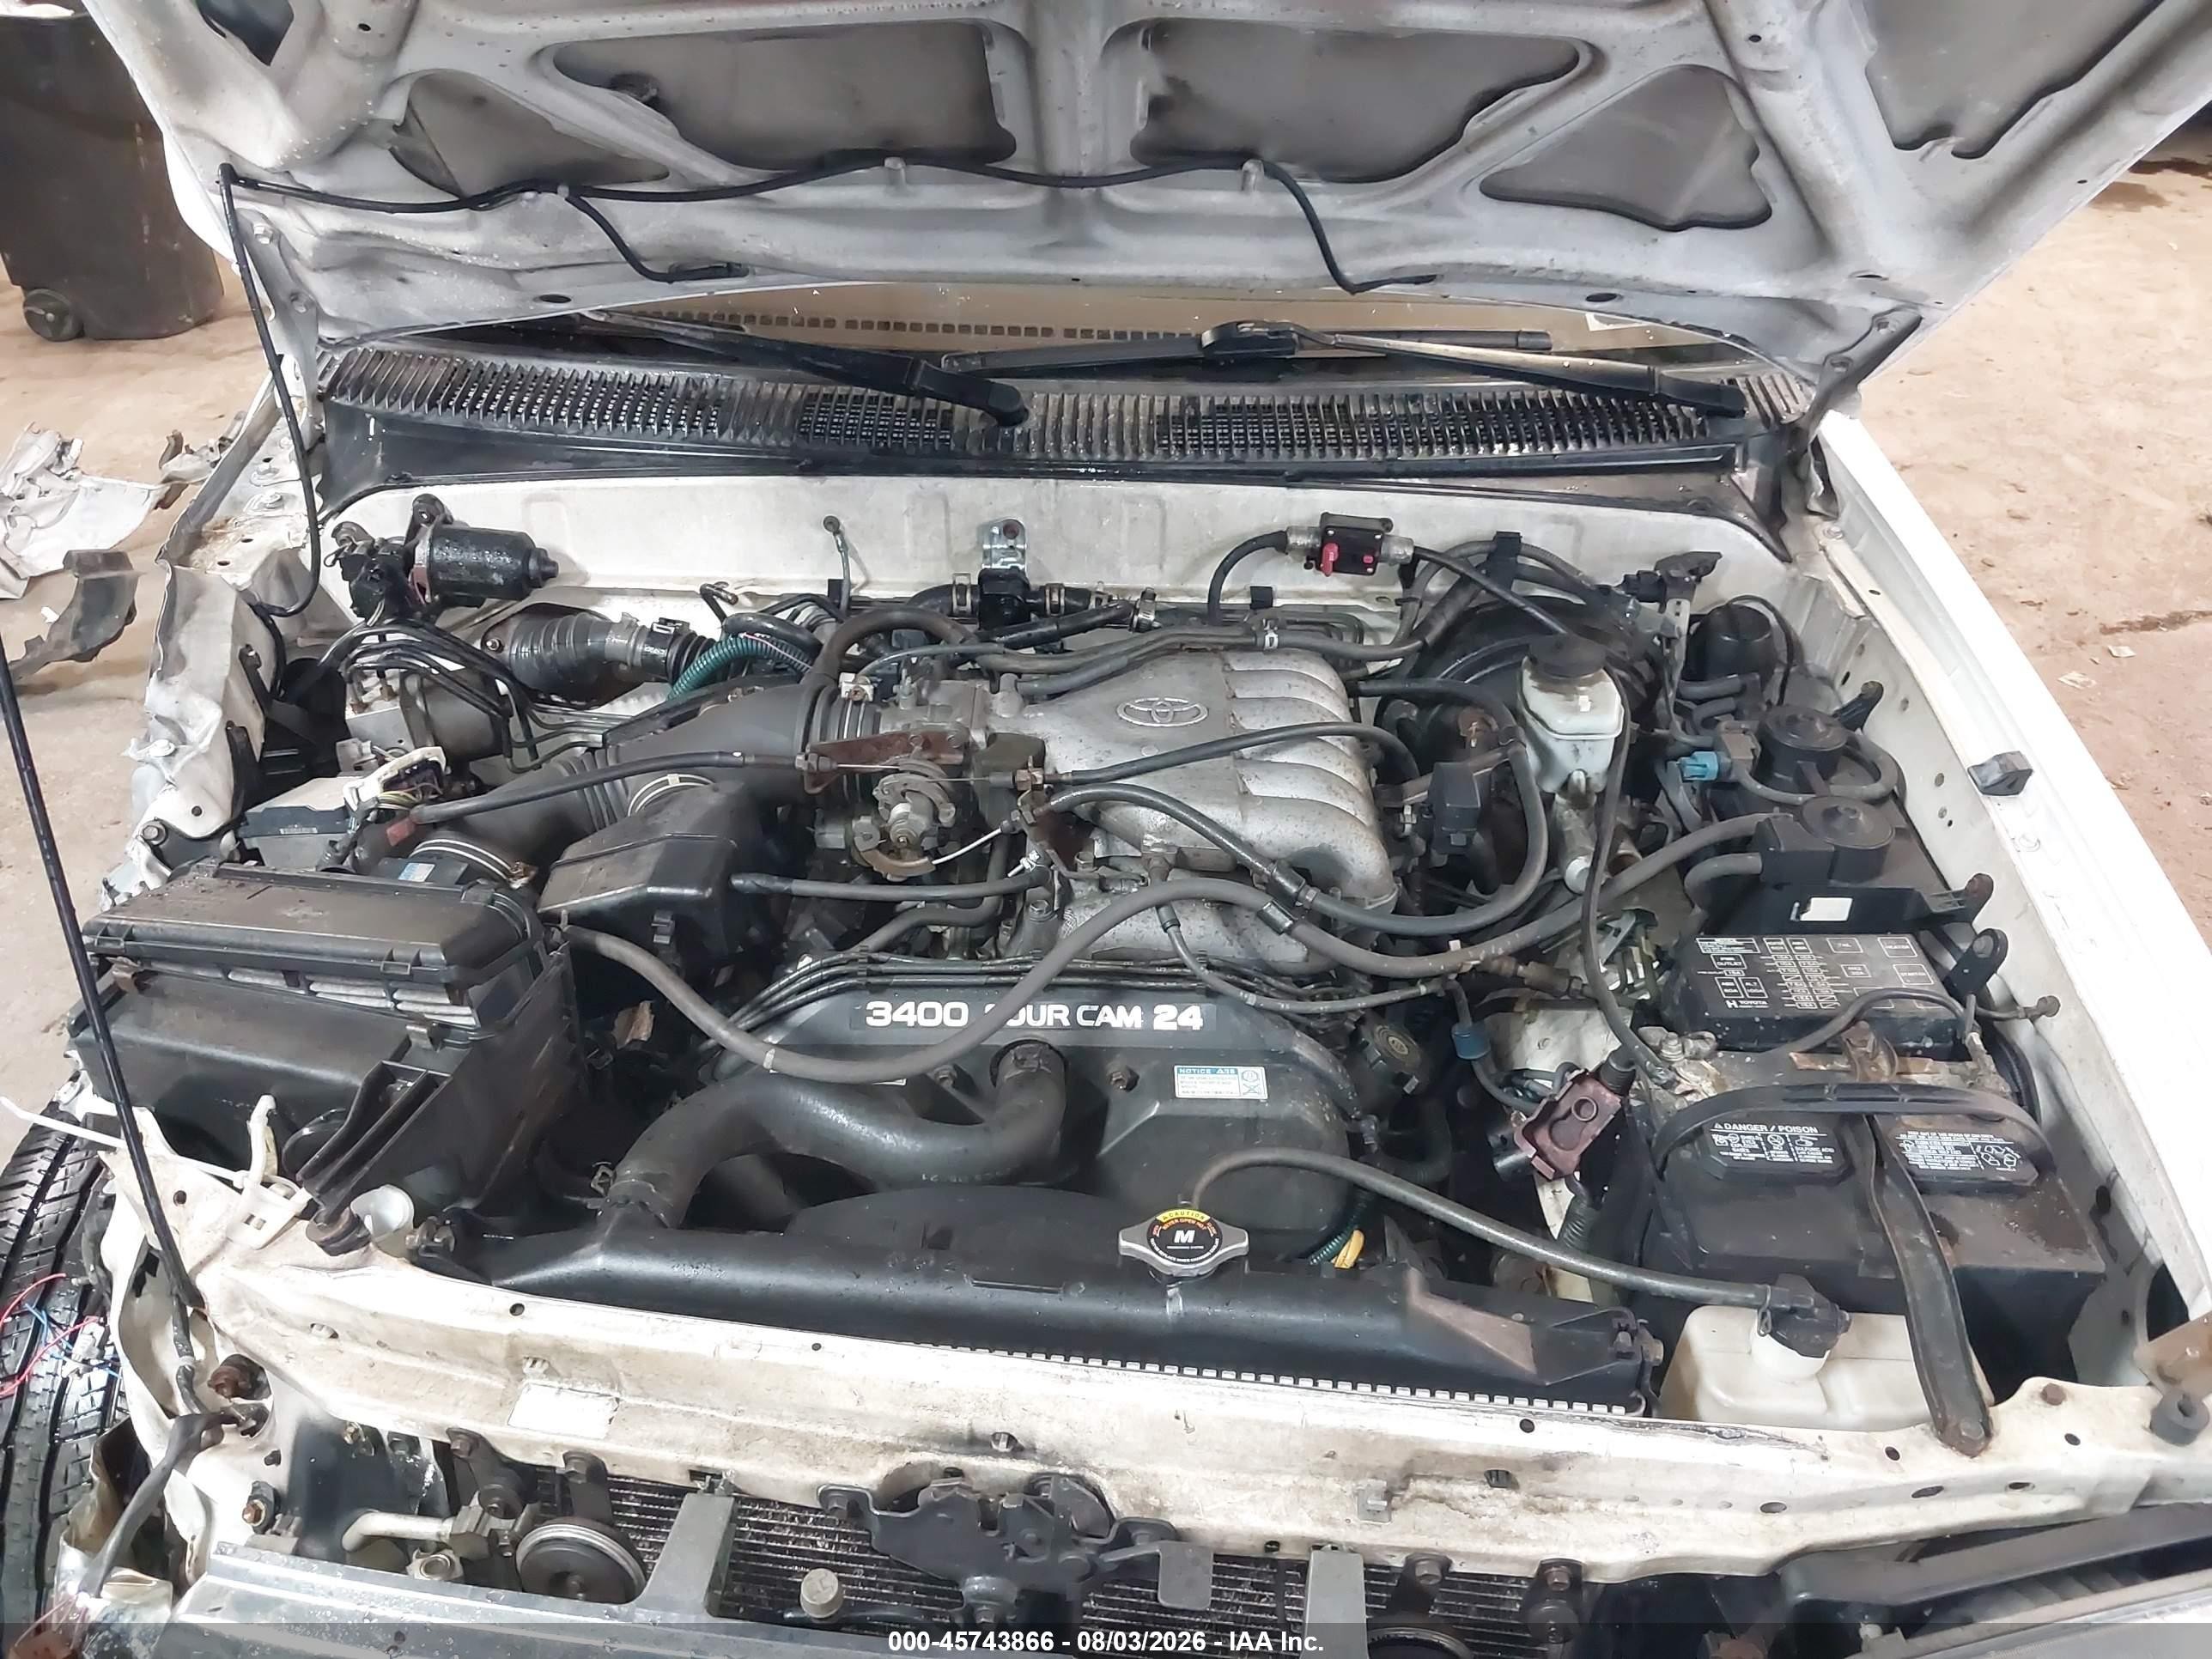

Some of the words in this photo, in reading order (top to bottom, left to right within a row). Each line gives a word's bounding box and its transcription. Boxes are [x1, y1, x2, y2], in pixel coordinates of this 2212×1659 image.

[866, 1001, 969, 1027] 3400
[984, 1003, 1071, 1027] OUR
[1076, 1004, 1143, 1028] CAM
[1153, 1004, 1203, 1030] 24
[1723, 1122, 1768, 1132] DANGER
[1778, 1125, 1818, 1133] POISON
[1169, 1211, 1205, 1219] CAUTION
[1174, 1230, 1195, 1243] M
